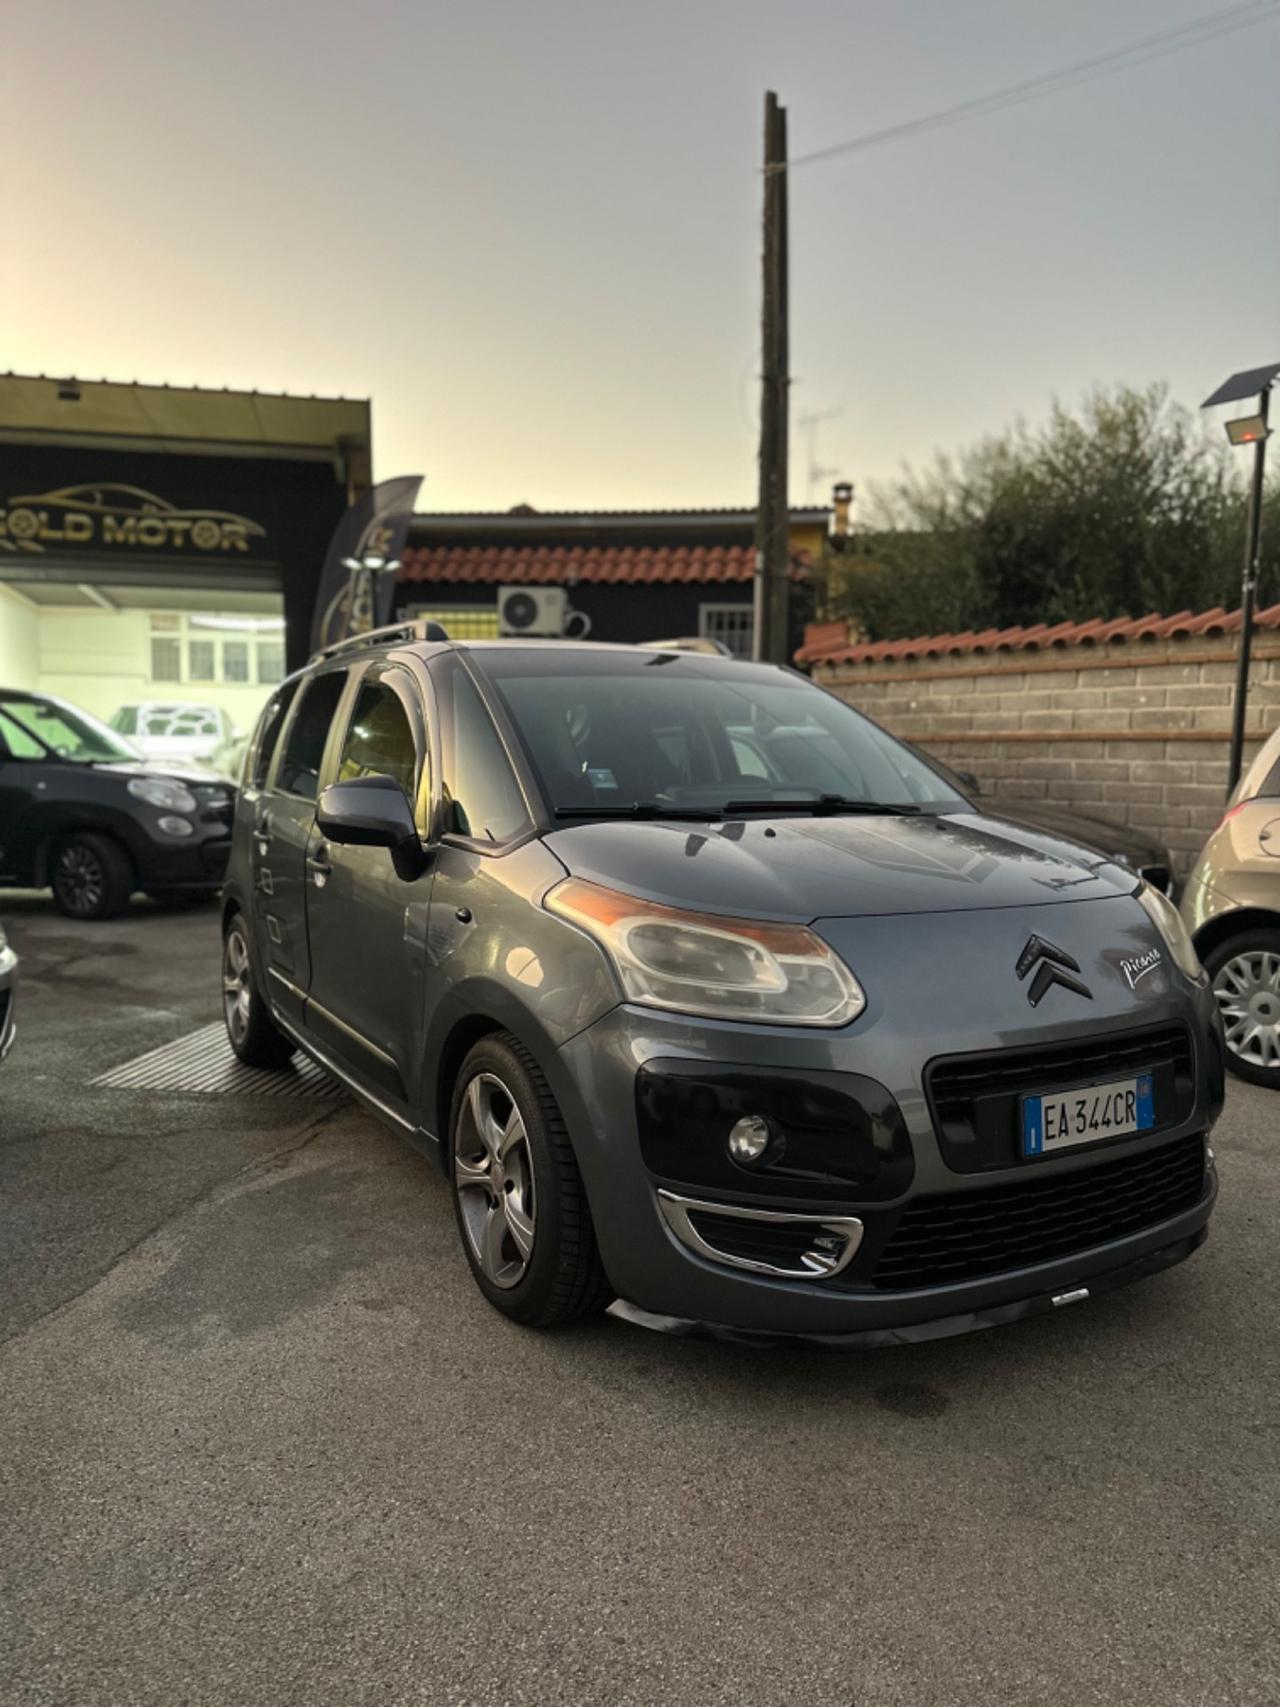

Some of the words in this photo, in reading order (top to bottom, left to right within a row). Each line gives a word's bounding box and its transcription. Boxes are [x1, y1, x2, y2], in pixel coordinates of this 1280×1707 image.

[0, 508, 94, 542] OLD
[102, 514, 249, 550] MOTOR
[1044, 1103, 1069, 1140] EA
[1075, 1089, 1136, 1134] 344CR
